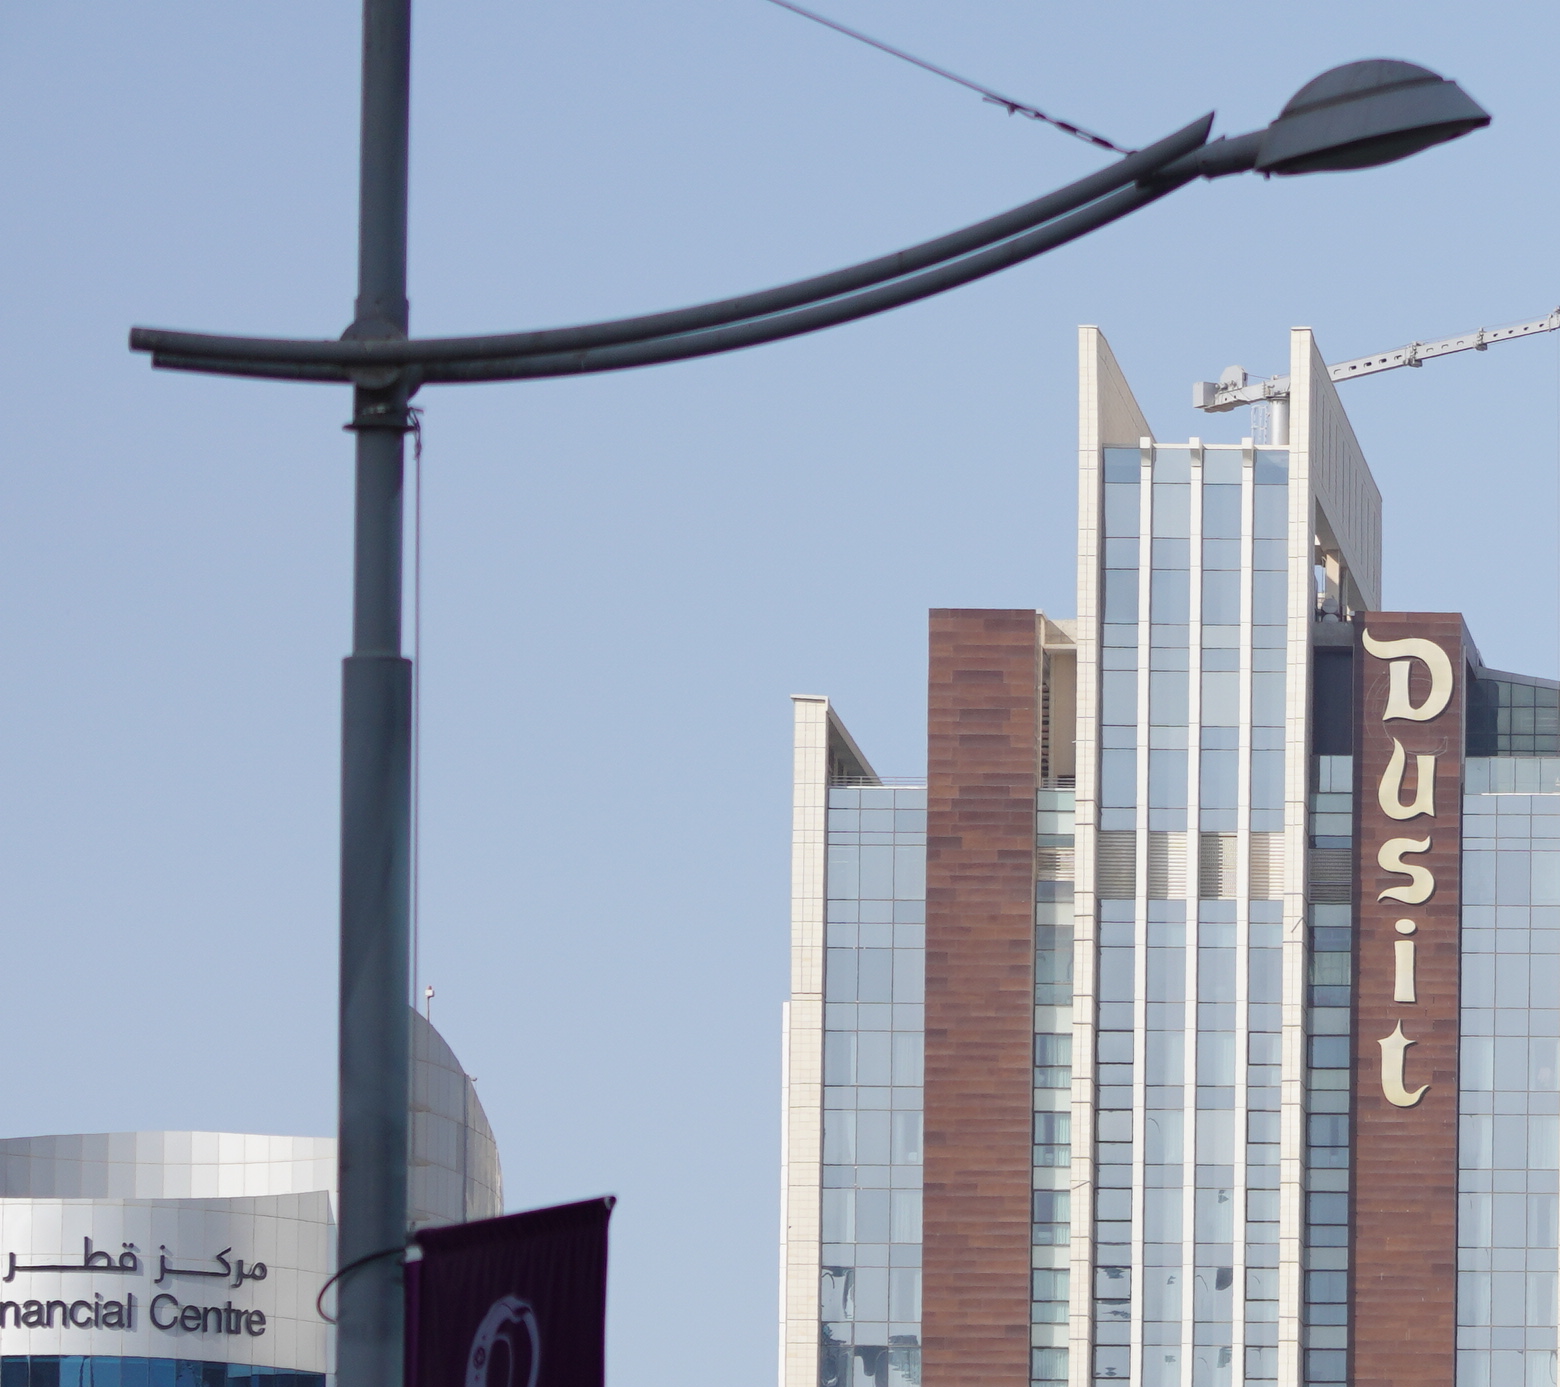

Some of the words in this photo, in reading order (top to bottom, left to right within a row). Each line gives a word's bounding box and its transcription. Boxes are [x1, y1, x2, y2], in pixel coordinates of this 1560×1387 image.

[1362, 627, 1453, 1107] Dusit
[2, 1235, 138, 1284] قطر
[153, 1244, 268, 1289] مركز
[150, 1293, 267, 1337] Centre
